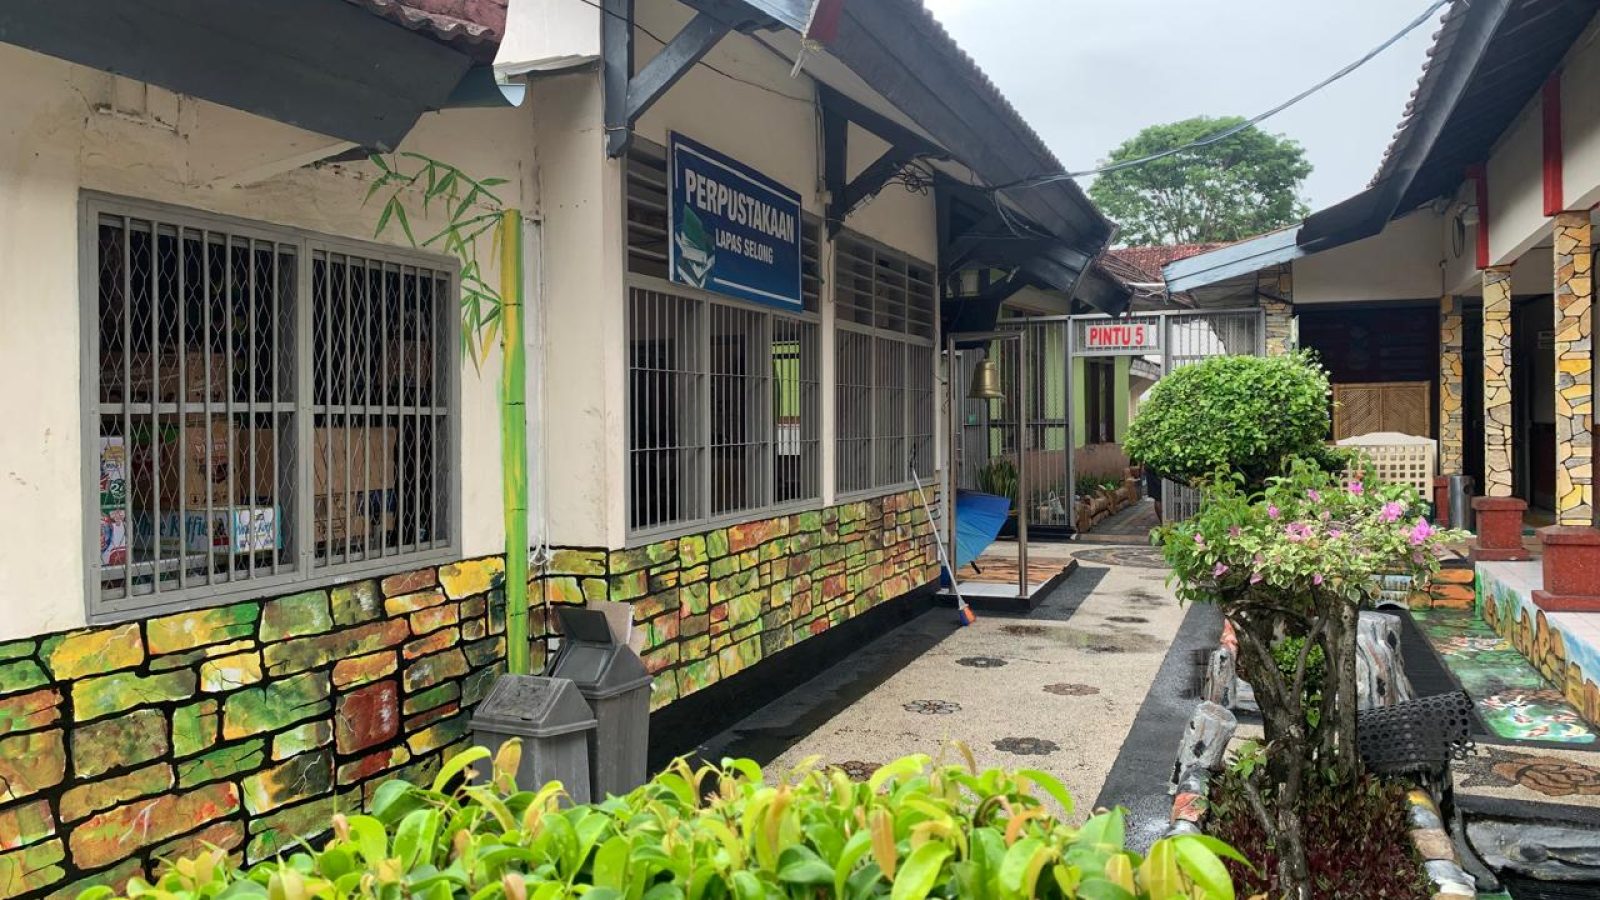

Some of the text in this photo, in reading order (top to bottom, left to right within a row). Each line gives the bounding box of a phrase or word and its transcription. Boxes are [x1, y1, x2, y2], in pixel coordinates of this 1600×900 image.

[685, 169, 794, 243] PERPUSTAKAAN
[715, 228, 774, 265] LAPAS SELONG
[1090, 327, 1144, 346] PINTU 5
